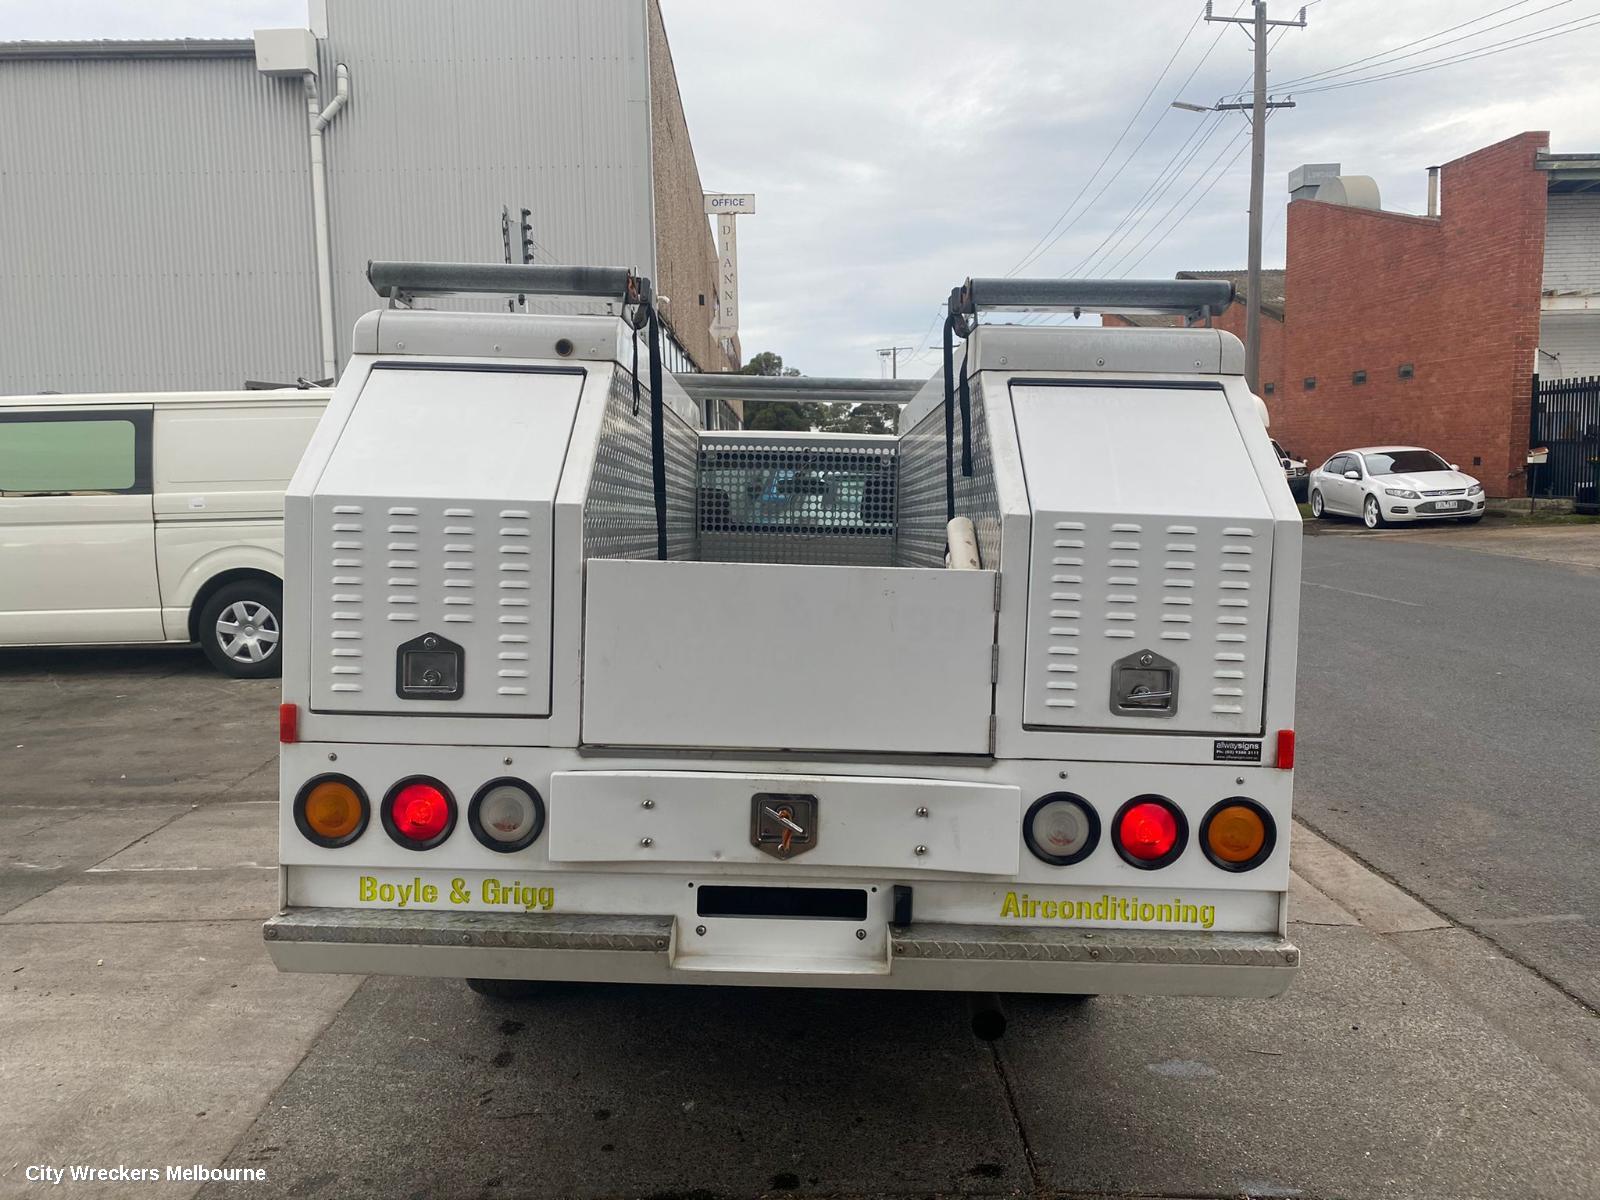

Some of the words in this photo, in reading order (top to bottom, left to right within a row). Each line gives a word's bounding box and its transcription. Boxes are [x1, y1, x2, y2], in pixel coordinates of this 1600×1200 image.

[711, 198, 745, 207] OFFICE
[722, 225, 734, 317] DIANNE
[359, 876, 438, 907] Boyle
[450, 878, 471, 904] &
[482, 878, 555, 910] Grigg
[999, 891, 1215, 929] Airconditioning
